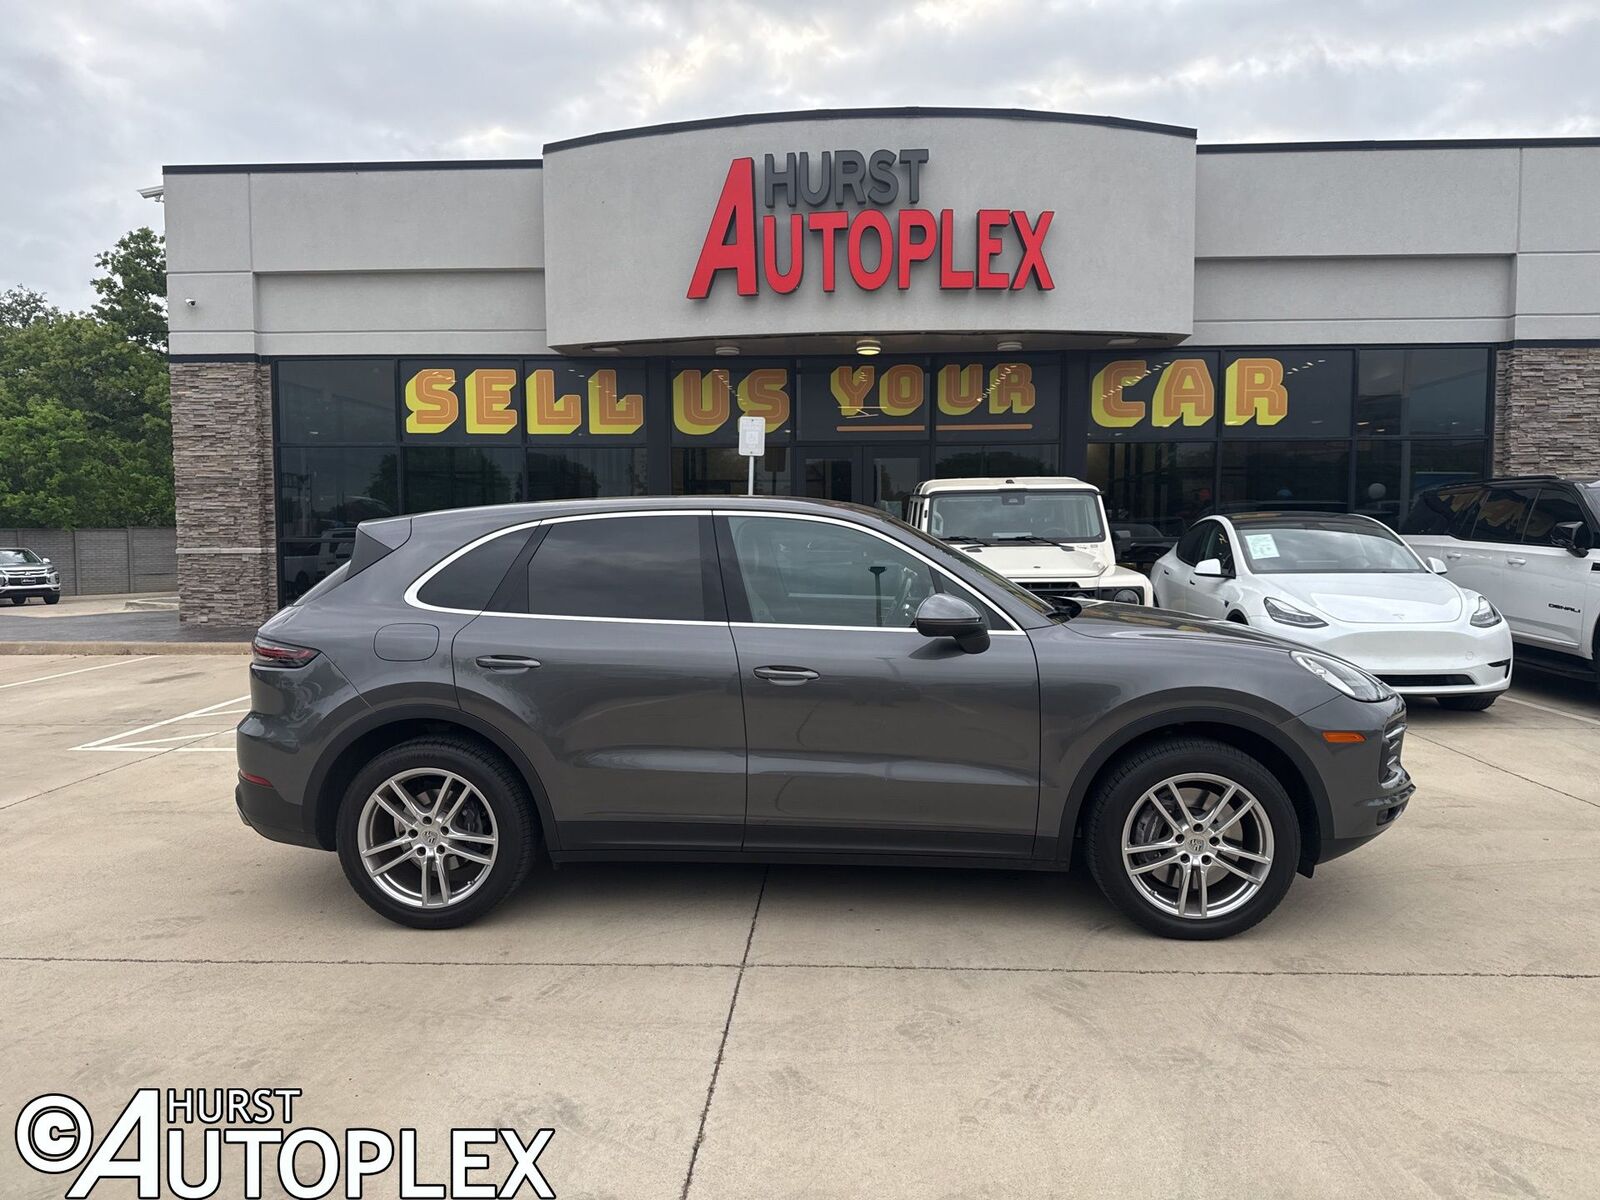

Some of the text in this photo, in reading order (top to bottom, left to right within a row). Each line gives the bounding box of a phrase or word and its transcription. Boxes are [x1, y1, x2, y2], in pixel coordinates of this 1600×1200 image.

[764, 148, 929, 208] HURST
[686, 156, 1055, 300] AUTOPLEX
[405, 357, 1289, 435] SELL US YOUR CAR
